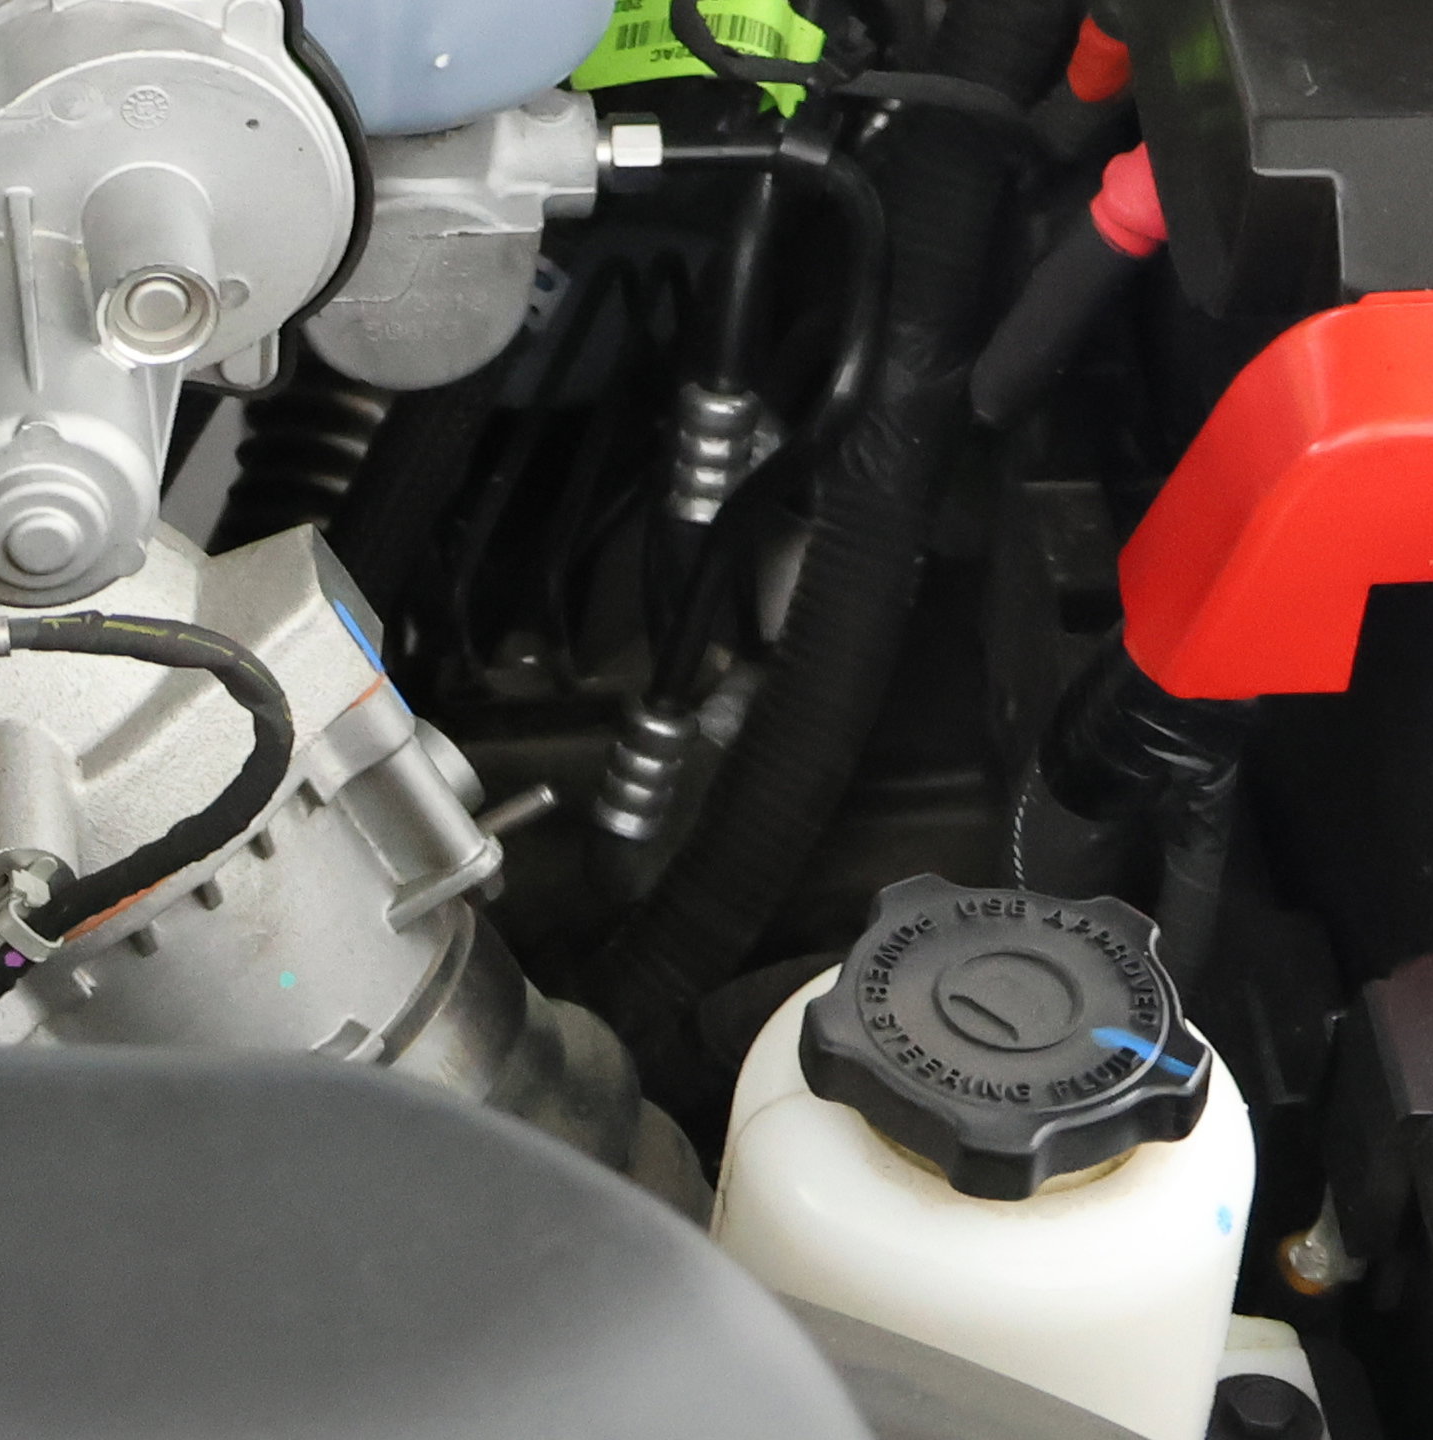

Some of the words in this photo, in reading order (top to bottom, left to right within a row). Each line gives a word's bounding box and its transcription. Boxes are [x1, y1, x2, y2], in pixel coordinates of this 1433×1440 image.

[956, 896, 1031, 920] USE
[1042, 908, 1160, 1028] APPROVED
[871, 1011, 1033, 1103] STEERING
